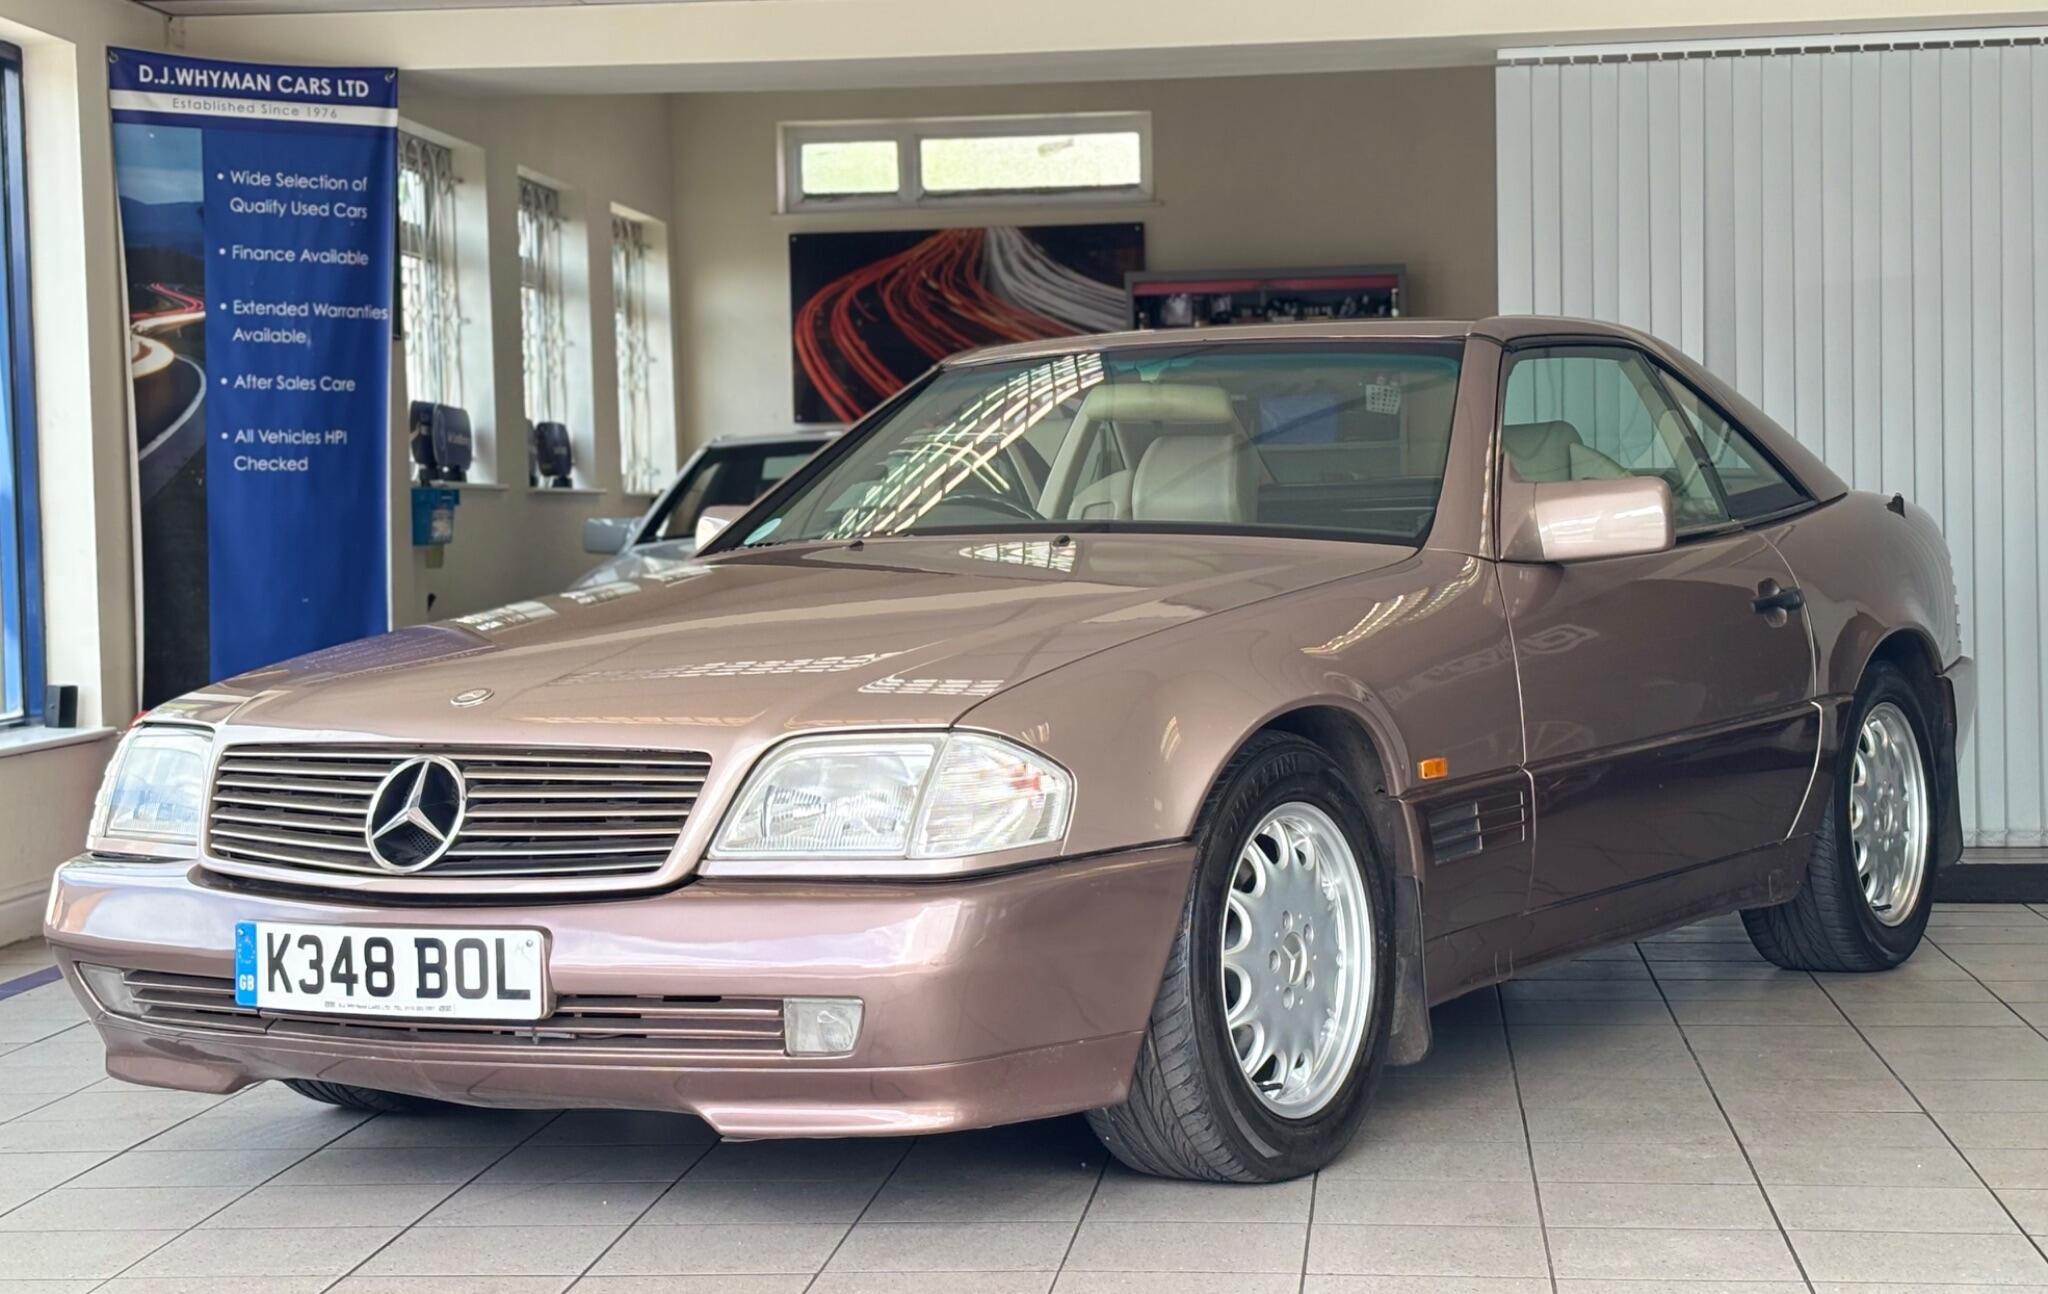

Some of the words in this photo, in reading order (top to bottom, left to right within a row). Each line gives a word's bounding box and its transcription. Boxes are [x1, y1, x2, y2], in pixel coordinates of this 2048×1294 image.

[138, 64, 271, 91] D.J.WHYMAN
[277, 75, 331, 95] CARS
[338, 79, 369, 98] LTD
[172, 98, 255, 114] Established
[261, 103, 300, 116] Since
[306, 106, 338, 119] 1976
[230, 170, 271, 187] Wide
[275, 173, 348, 191] Selection
[352, 177, 368, 191] of
[230, 198, 287, 218] Quality
[291, 200, 330, 217] Used
[333, 203, 368, 219] Cars
[232, 245, 295, 262] Finance
[300, 249, 369, 265] Available
[232, 300, 308, 317] Extended
[313, 304, 389, 320] Warranties
[233, 374, 272, 389] After
[276, 376, 317, 391] Sales
[320, 377, 356, 392] Care
[234, 429, 254, 443] All
[258, 430, 321, 445] Vehicles
[325, 431, 348, 445] HPI
[234, 456, 308, 471] Checked
[266, 932, 395, 998] K348
[414, 937, 531, 1000] BOL
[239, 974, 255, 991] GB
